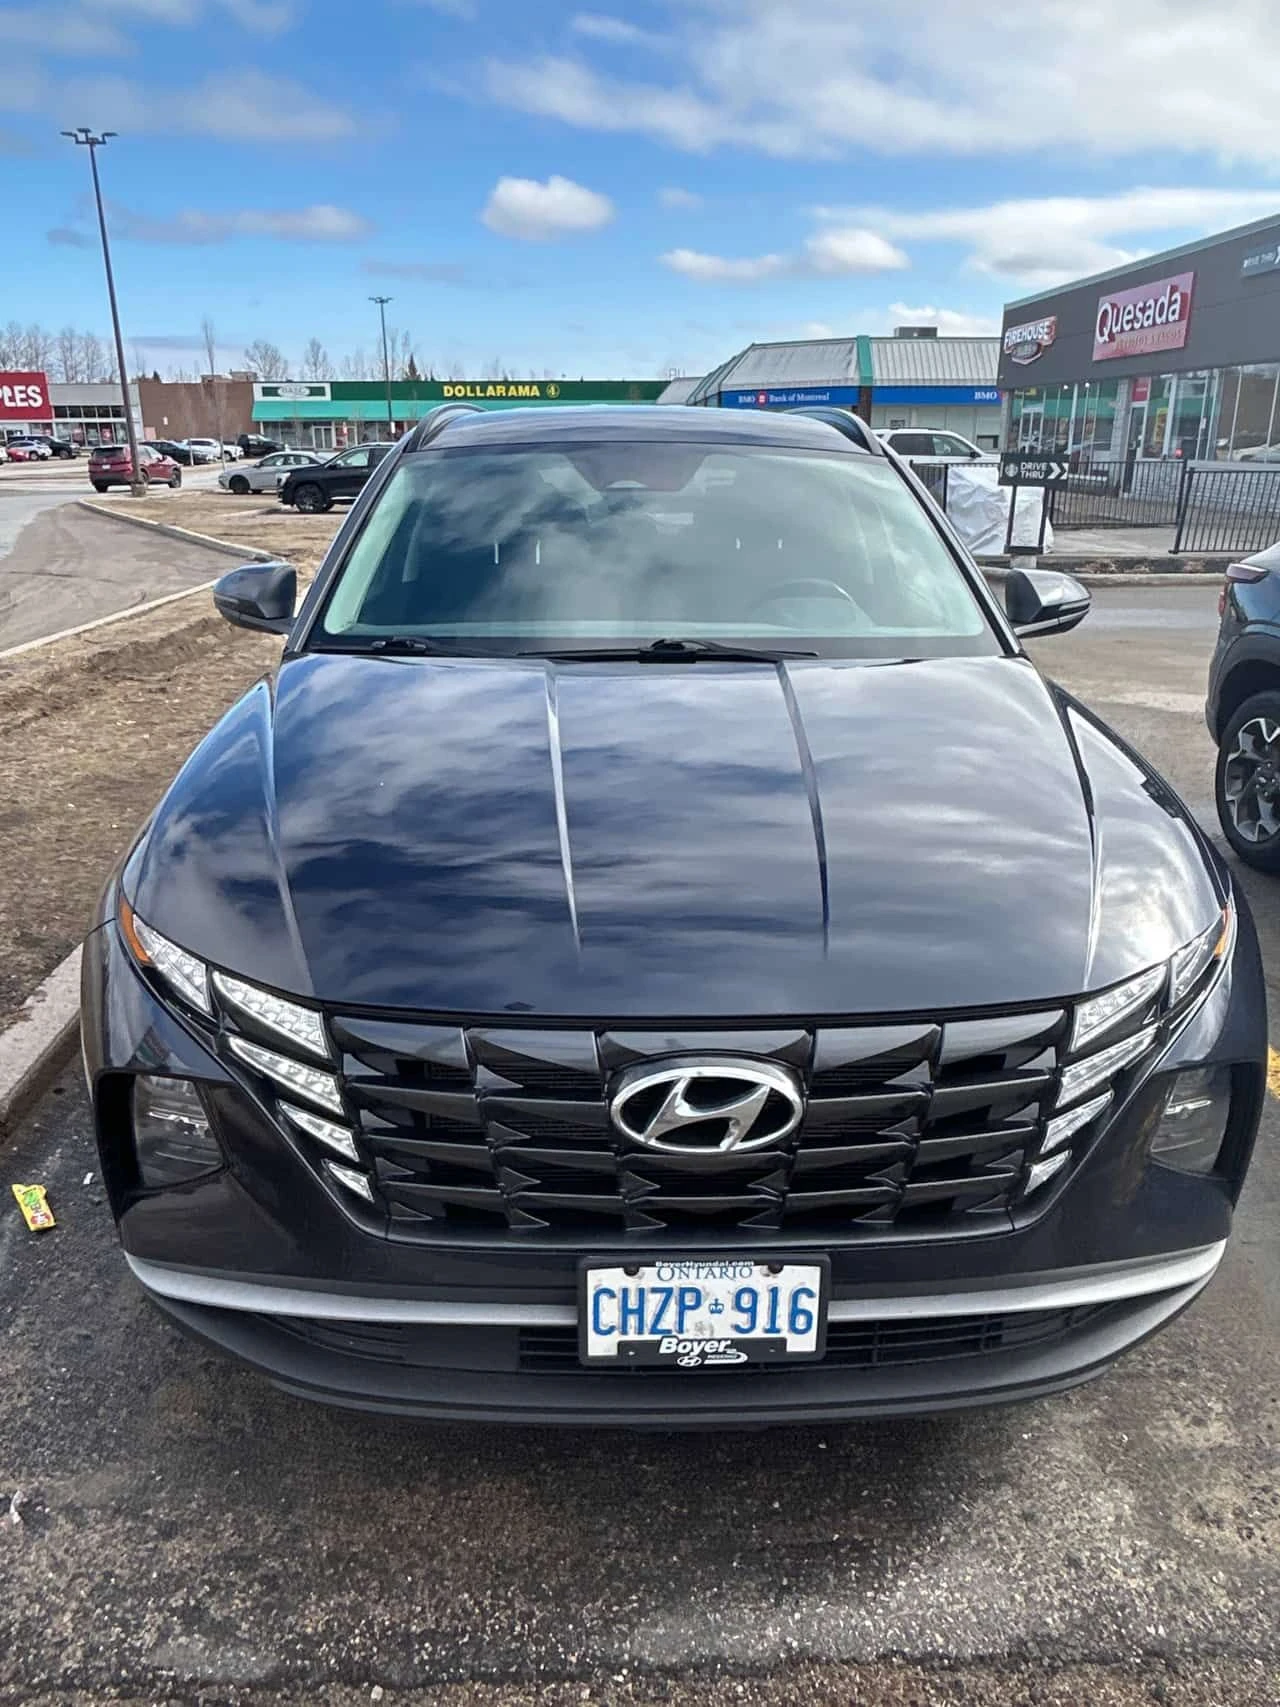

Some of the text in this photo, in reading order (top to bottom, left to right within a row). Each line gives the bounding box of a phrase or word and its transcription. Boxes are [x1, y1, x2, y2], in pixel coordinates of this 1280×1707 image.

[1096, 284, 1181, 343] Quesada
[1004, 320, 1050, 348] FIREHOUSE
[0, 385, 43, 408] LES
[443, 385, 540, 397] DOLLARAMA
[769, 394, 787, 403] Bank
[788, 393, 796, 402] of
[797, 391, 830, 402] Montreal
[974, 391, 997, 400] BMO
[1020, 462, 1048, 471] DRIVE
[1020, 470, 1045, 479] THRU
[657, 1266, 753, 1281] ONTARIO
[592, 1286, 816, 1336] CHZP 916
[659, 1337, 732, 1356] Boyer
